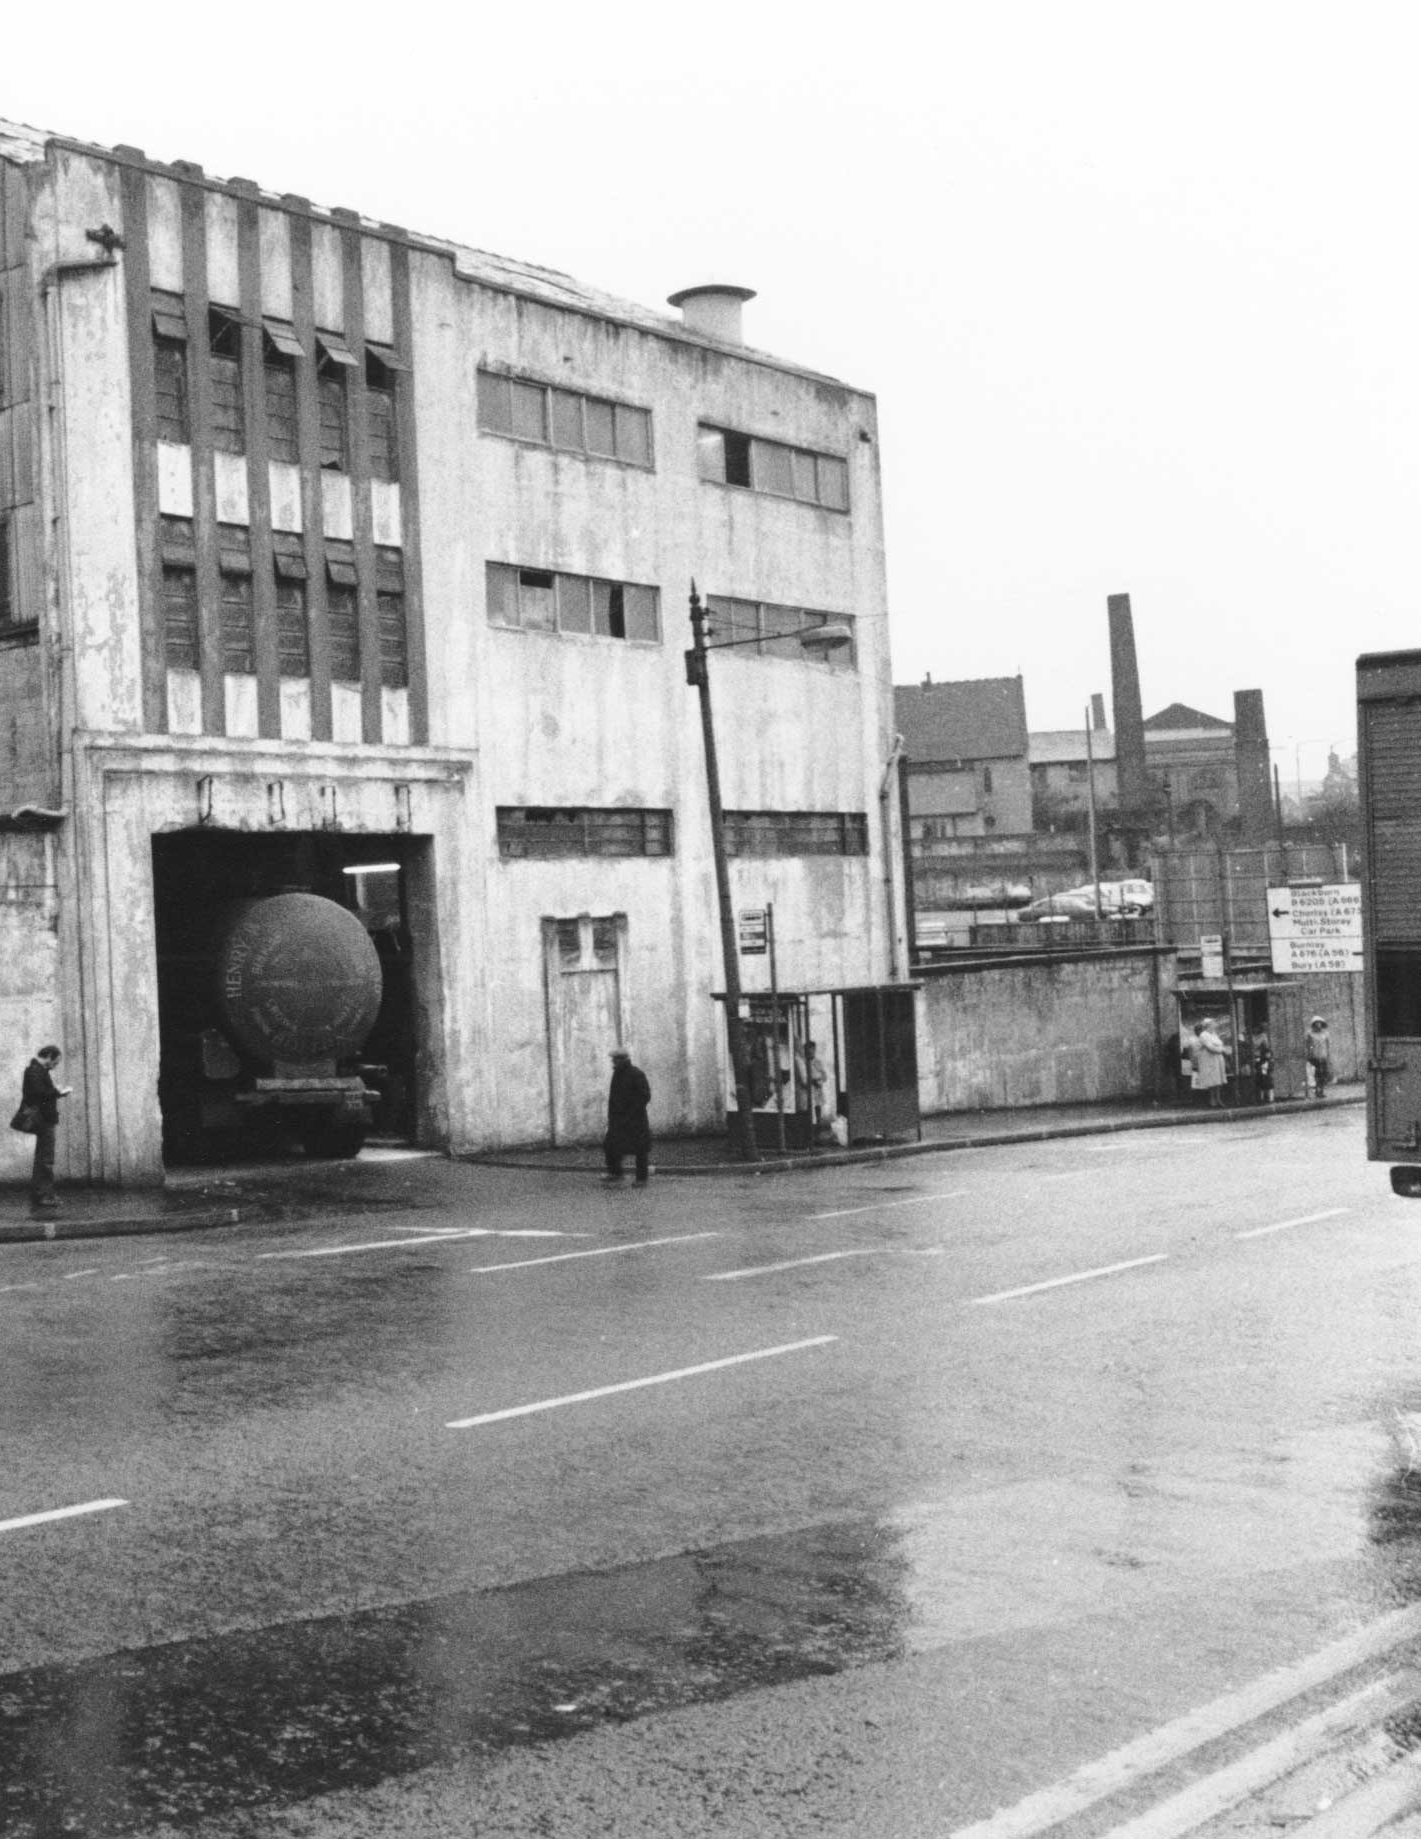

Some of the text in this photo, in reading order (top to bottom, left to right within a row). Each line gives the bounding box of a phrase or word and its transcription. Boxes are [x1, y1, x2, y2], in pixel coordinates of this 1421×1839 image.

[1300, 926, 1341, 935] Car Park
[225, 937, 251, 999] HENRY
[1291, 962, 1312, 970] Bury
